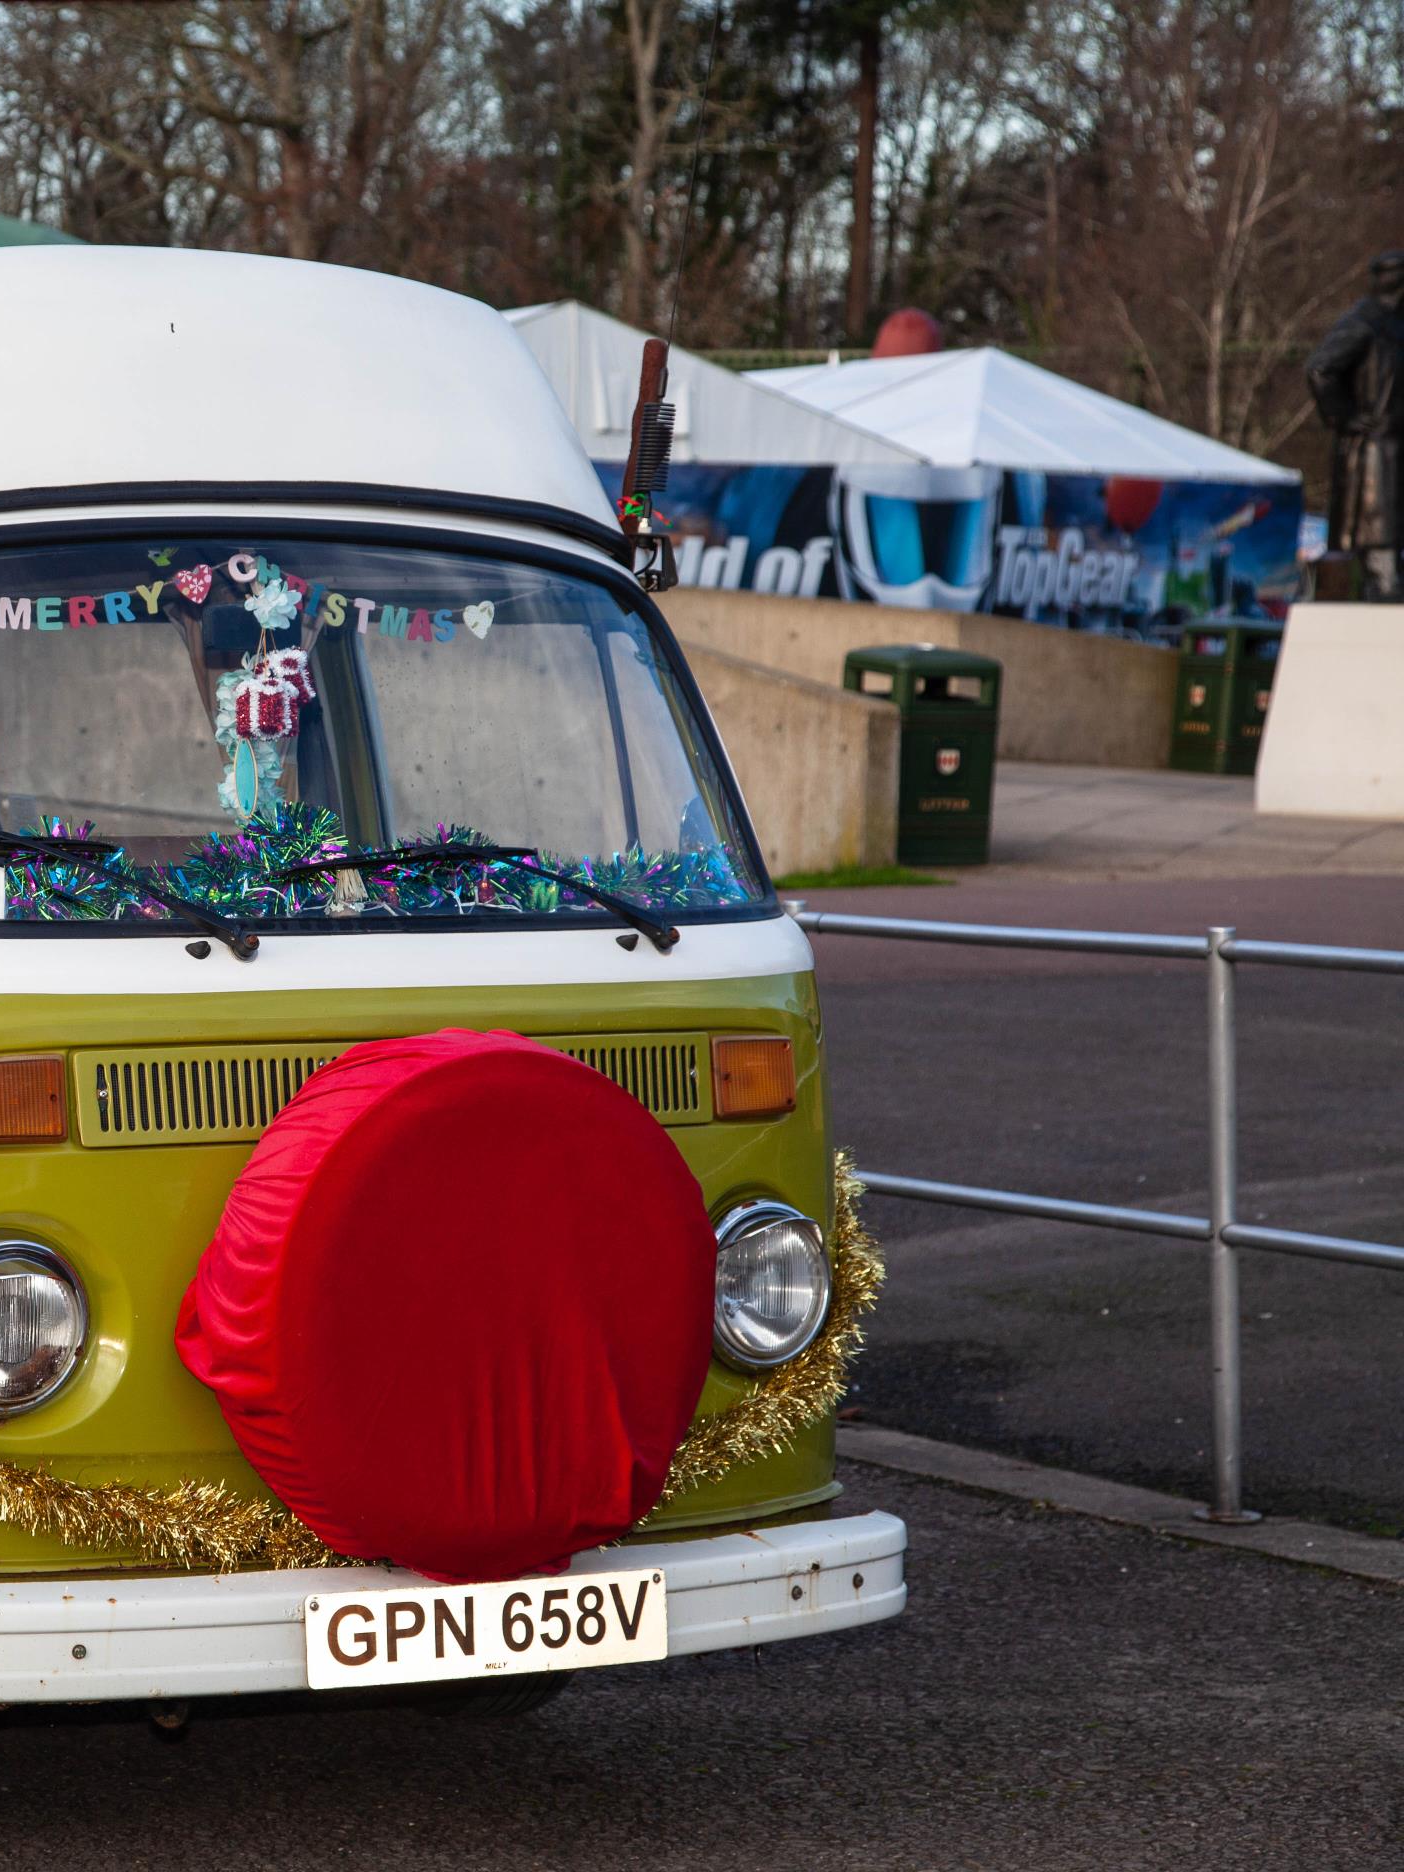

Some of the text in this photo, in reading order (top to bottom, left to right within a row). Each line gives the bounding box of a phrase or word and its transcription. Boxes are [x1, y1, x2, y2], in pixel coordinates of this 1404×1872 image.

[753, 535, 836, 598] of
[327, 1580, 649, 1667] GPN 658V
[484, 1660, 508, 1670] MILLY
